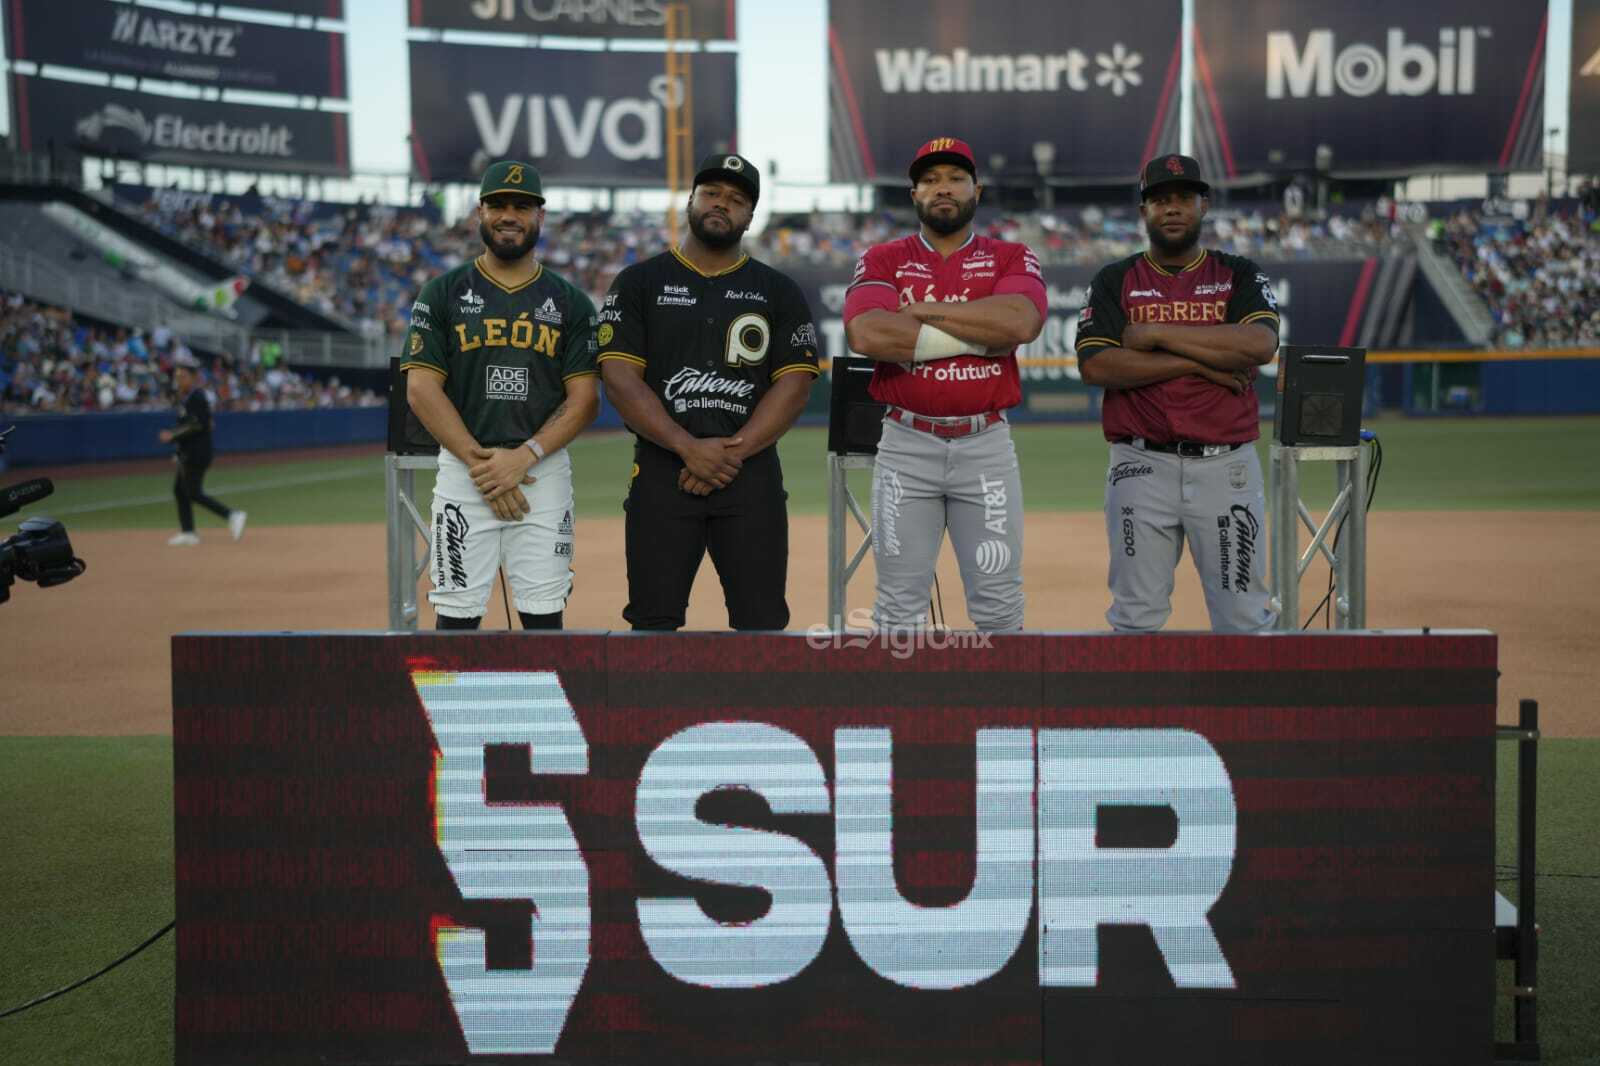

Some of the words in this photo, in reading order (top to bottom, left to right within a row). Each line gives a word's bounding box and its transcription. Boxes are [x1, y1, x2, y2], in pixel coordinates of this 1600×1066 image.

[875, 48, 1089, 93] Walmart
[1266, 26, 1476, 99] Mobil
[455, 312, 561, 359] LEÓN
[491, 367, 525, 380] ADE
[662, 366, 755, 400] Caliente
[979, 473, 1007, 536] AT&T
[444, 503, 470, 590] Caliente
[1230, 502, 1260, 594] Caliente
[635, 720, 1238, 989] SUR
